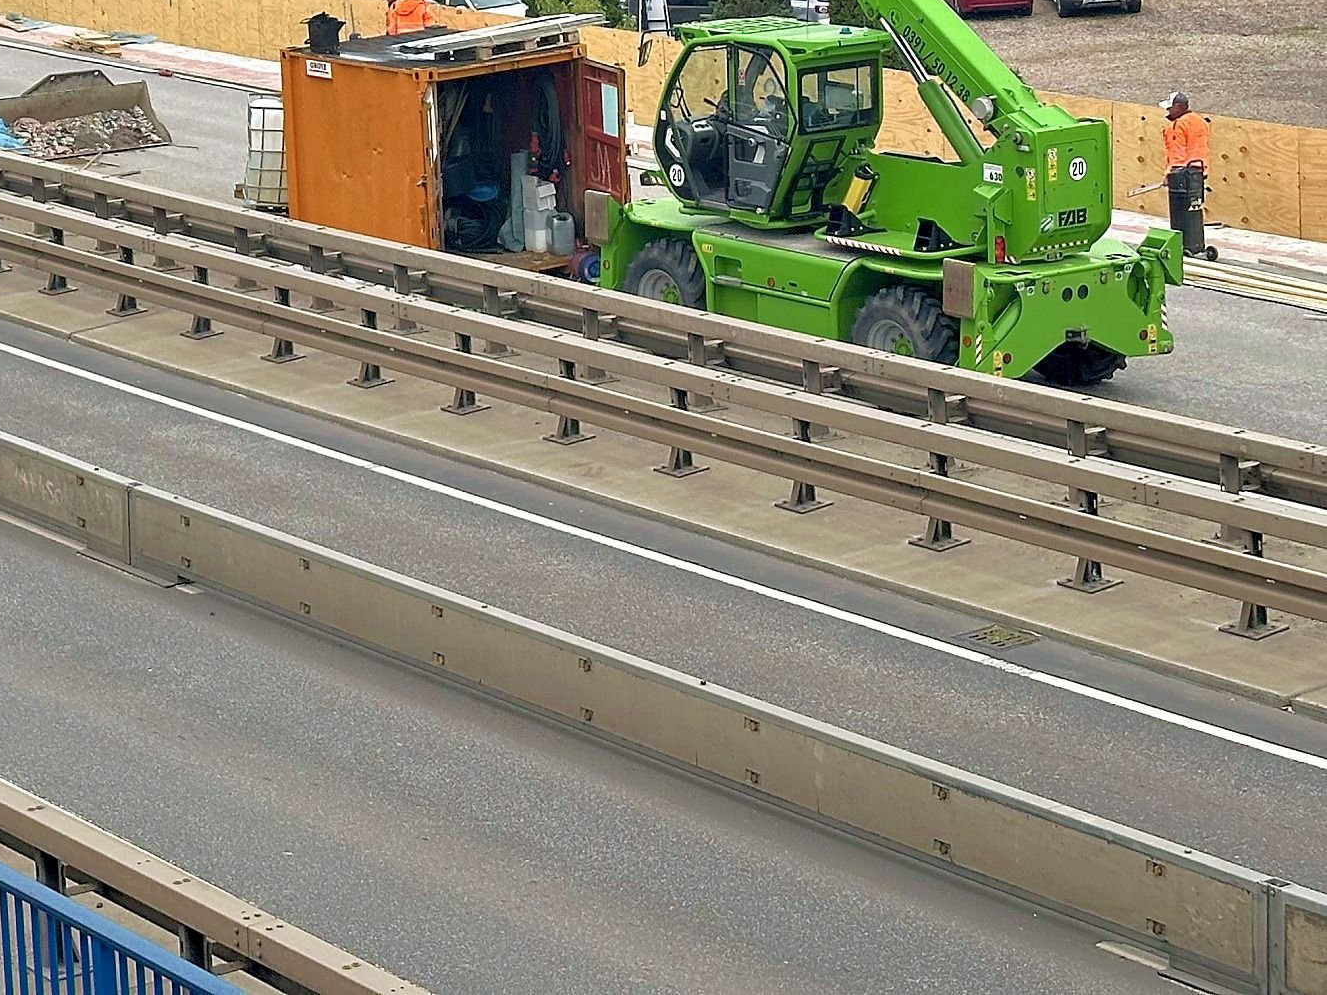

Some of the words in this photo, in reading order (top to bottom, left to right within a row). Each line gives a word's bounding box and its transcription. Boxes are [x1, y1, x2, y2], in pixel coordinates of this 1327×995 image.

[903, 25, 926, 54] 0391
[933, 58, 946, 75] 50
[945, 71, 958, 89] 12
[956, 84, 971, 102] 38
[672, 168, 682, 182] 20
[1072, 162, 1084, 176] 20
[989, 172, 1003, 181] 630
[1058, 208, 1087, 227] FAB
